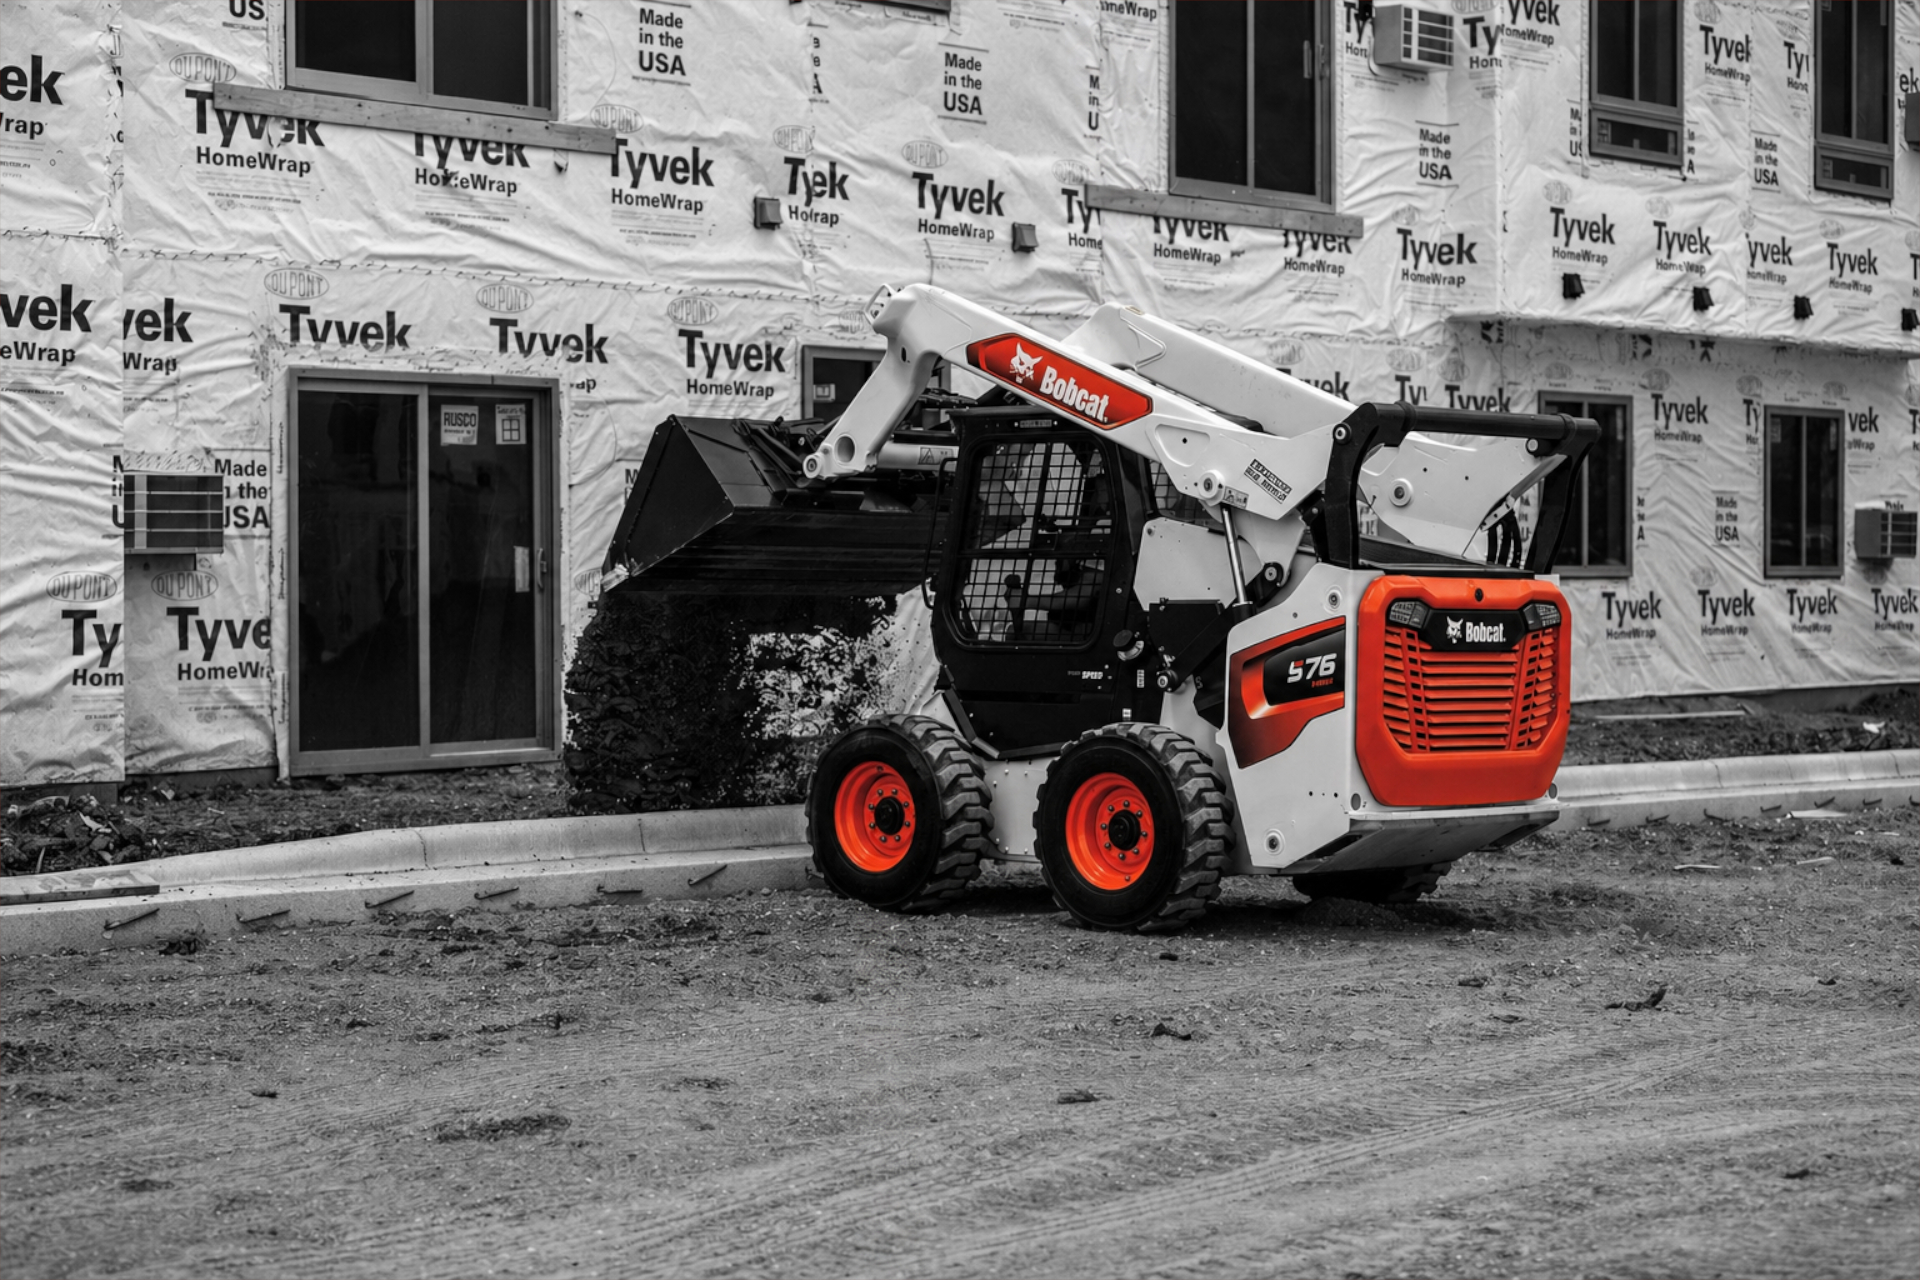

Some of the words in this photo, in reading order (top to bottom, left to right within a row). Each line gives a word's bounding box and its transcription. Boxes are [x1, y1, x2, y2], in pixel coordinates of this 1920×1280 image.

[639, 8, 684, 29] Made
[639, 28, 654, 45] in
[658, 31, 684, 49] the
[638, 50, 687, 77] USA
[944, 52, 982, 72] Made
[944, 72, 957, 88] in
[961, 74, 982, 91] the
[944, 91, 983, 116] USA
[0, 113, 44, 140] rap
[196, 146, 312, 178] HomeWrap
[611, 138, 715, 189] Tyvek
[1419, 161, 1453, 181] USA
[1754, 168, 1780, 187] USA
[611, 188, 704, 215] HomeWrap
[912, 171, 1005, 219] Tyvek
[918, 218, 995, 244] HomeWrap
[1550, 206, 1615, 247] Tyvek
[1396, 228, 1477, 270] Tyvek
[1653, 220, 1712, 260] Tyvek
[1154, 243, 1221, 265] HomeWrap
[1284, 256, 1345, 277] HomeWrap
[1552, 246, 1608, 266] HomeWrap
[1827, 242, 1878, 278] Tyvek
[1401, 268, 1466, 287] HomeWrap
[678, 328, 786, 379] Tyvek
[687, 378, 775, 400] HomeWrap
[444, 412, 477, 427] RUSCO
[1651, 393, 1708, 430] Tyvek
[214, 459, 267, 476] Made
[239, 482, 267, 499] the
[1715, 525, 1739, 541] USA
[1602, 591, 1661, 627] Tyvek
[1698, 589, 1755, 625] Tyvek
[1787, 588, 1838, 622] Tyvek
[1871, 588, 1918, 620] Tyvek
[1287, 653, 1337, 684] S76
